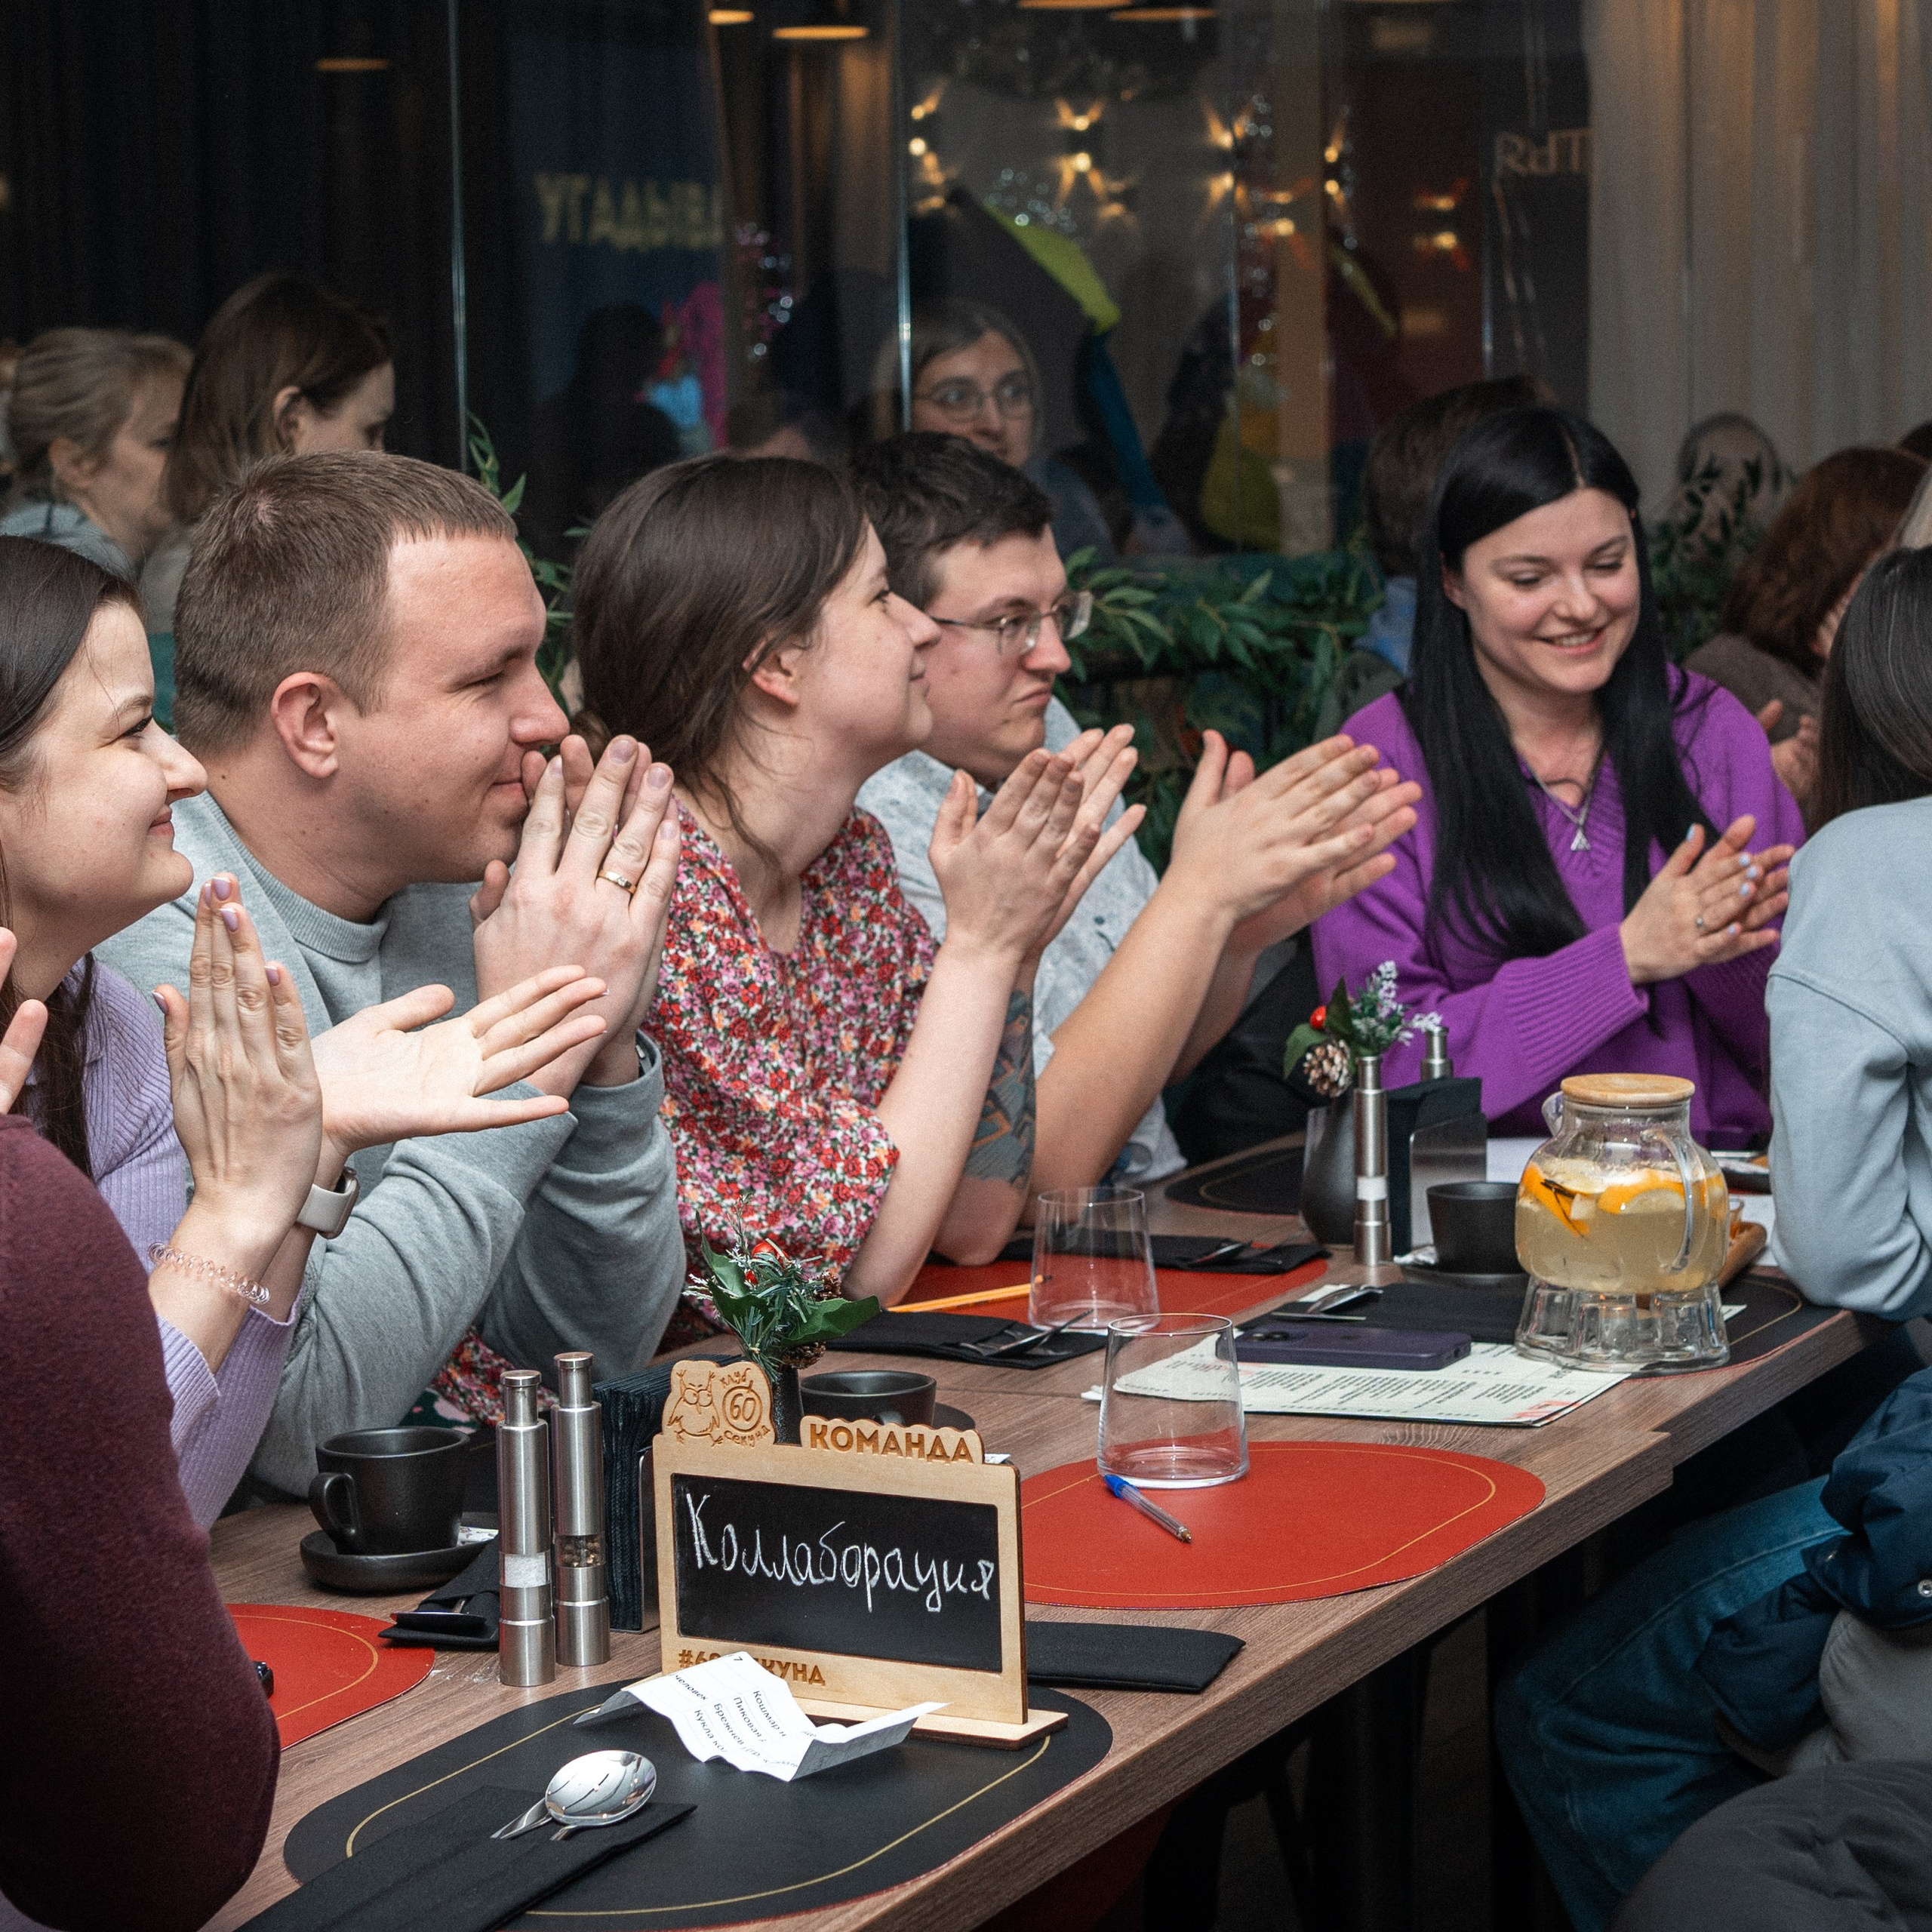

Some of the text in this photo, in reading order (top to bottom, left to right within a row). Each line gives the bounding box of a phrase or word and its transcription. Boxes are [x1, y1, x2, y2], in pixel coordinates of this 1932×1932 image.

[730, 1393, 757, 1422] 60
[810, 1423, 974, 1464] КОМАНДА
[686, 1493, 995, 1613] Коллаборация
[694, 1709, 714, 1740] Кукла
[733, 1697, 762, 1737] Пиковая
[752, 1690, 780, 1730] Кошмар
